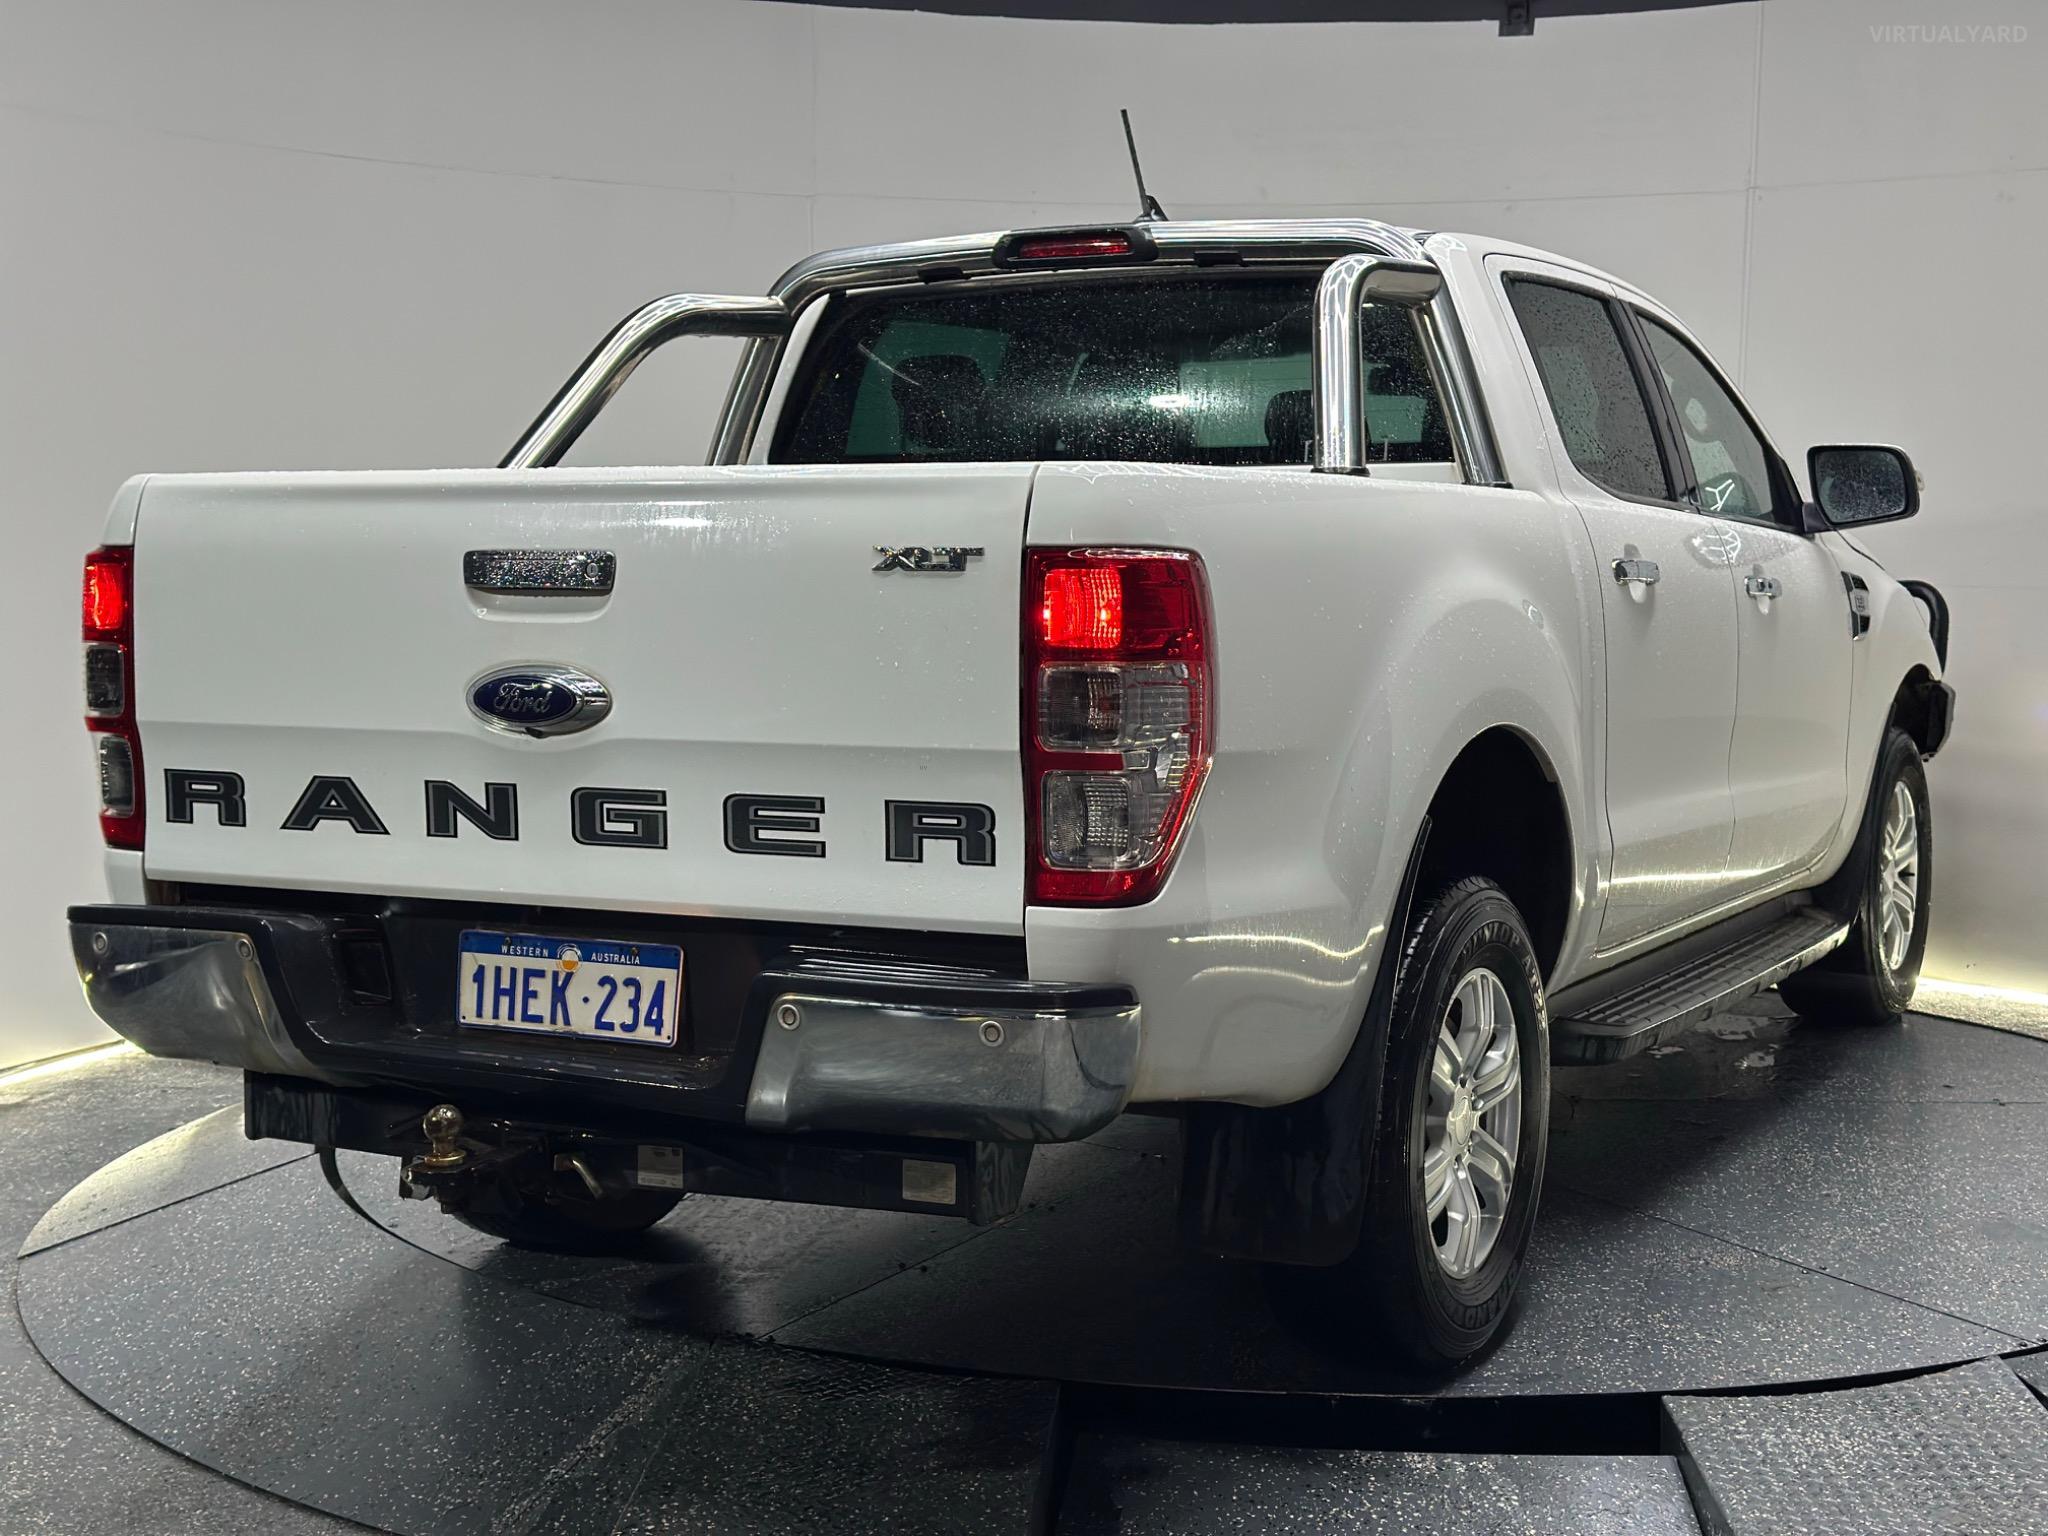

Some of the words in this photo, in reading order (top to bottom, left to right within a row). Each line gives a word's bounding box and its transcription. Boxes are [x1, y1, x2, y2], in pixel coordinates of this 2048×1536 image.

[872, 545, 985, 572] XLT
[493, 682, 553, 713] Ford
[164, 768, 997, 867] RANGER
[501, 944, 549, 958] WESTERN
[591, 951, 641, 965] AUSTRALIA
